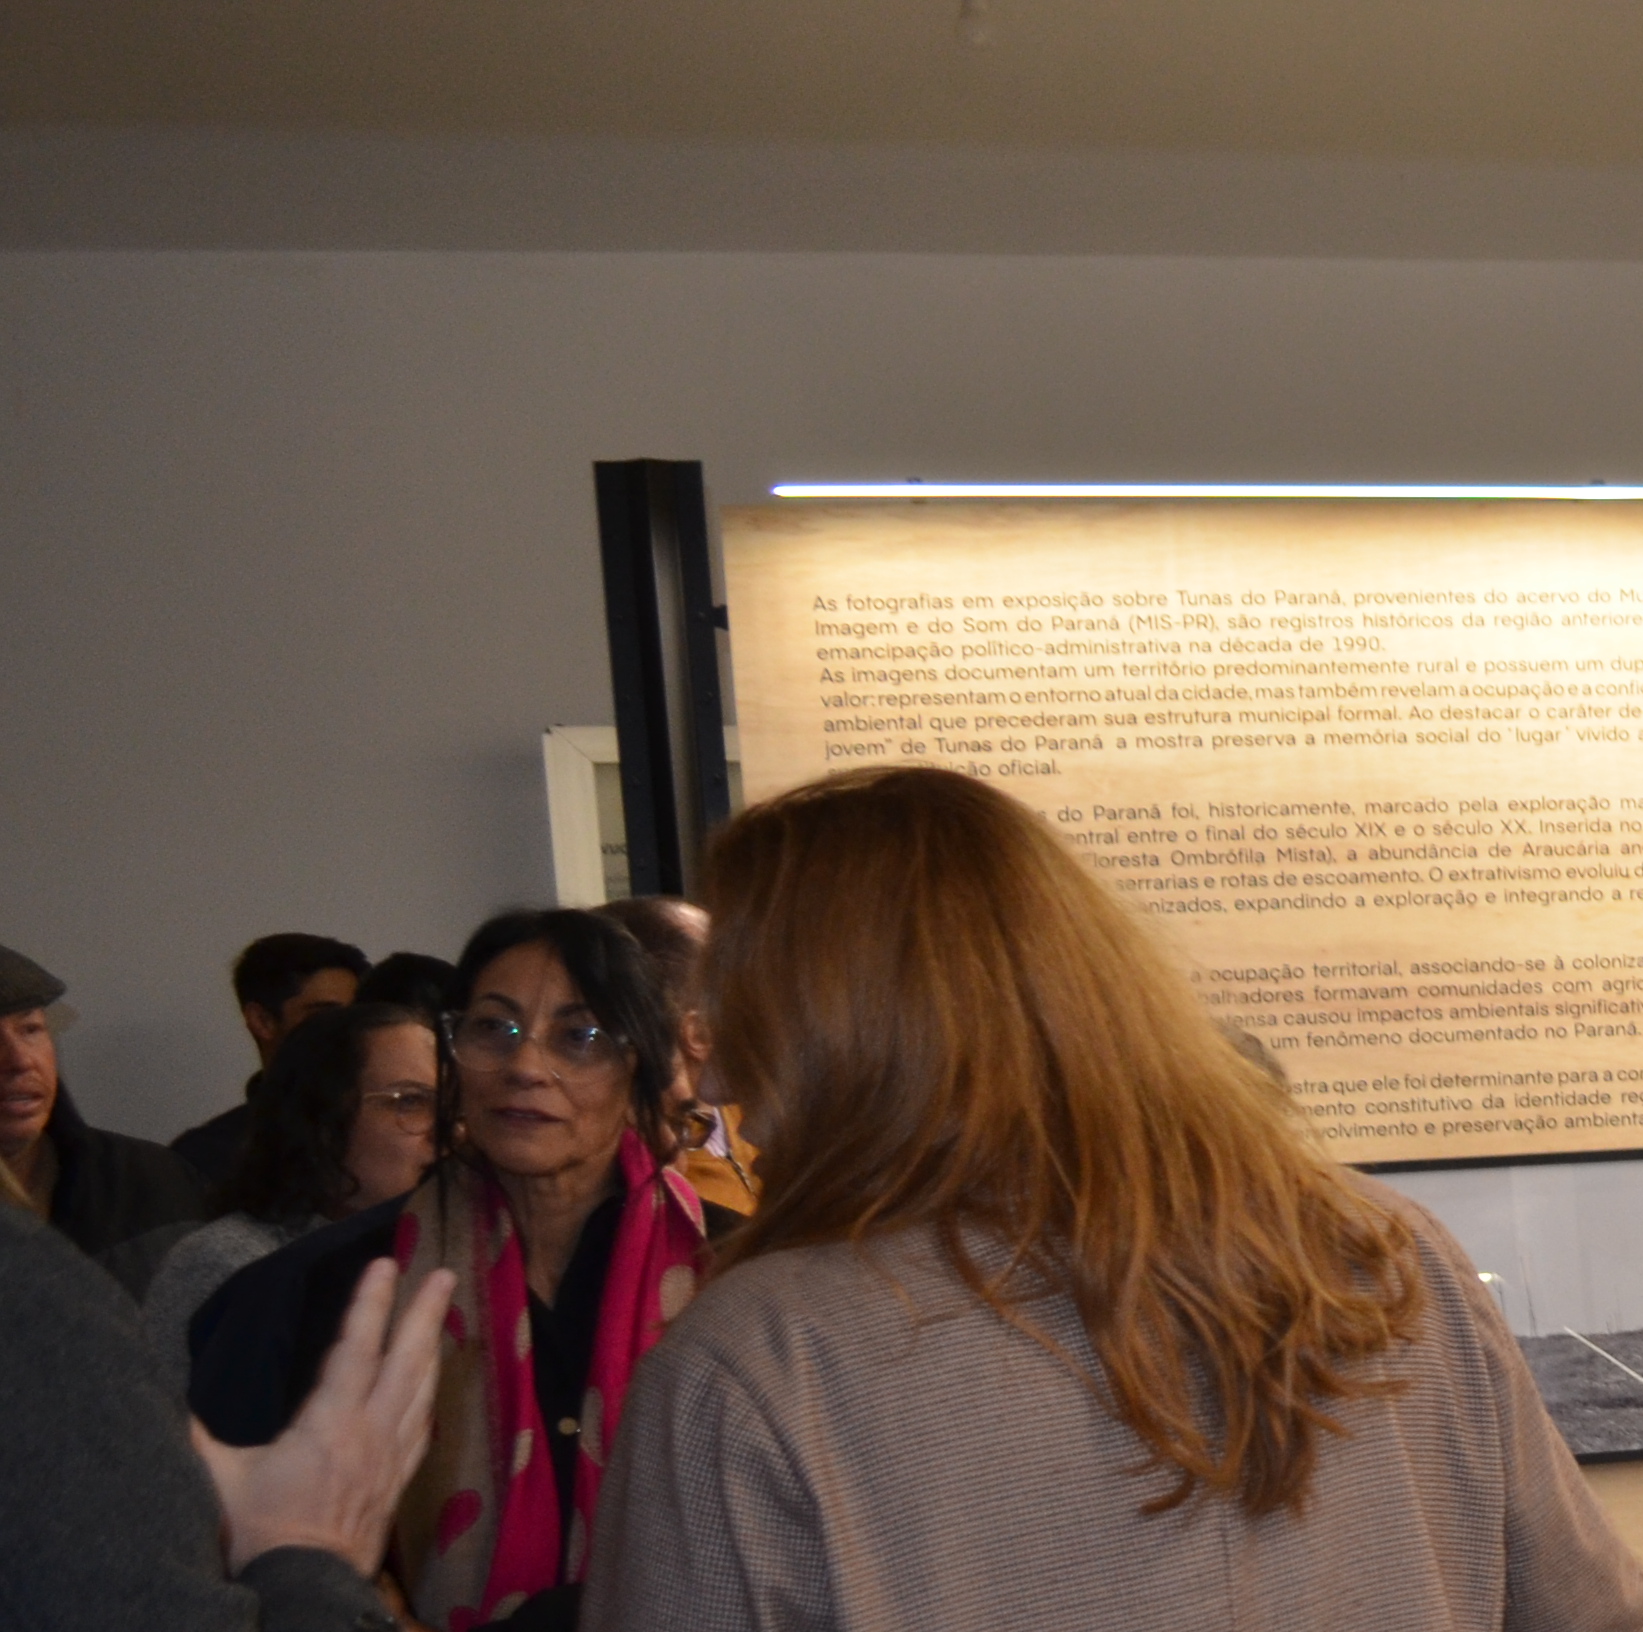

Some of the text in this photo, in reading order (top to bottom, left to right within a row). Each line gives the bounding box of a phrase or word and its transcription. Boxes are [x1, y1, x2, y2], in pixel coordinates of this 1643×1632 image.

[813, 595, 838, 612] As
[846, 593, 954, 615] fotografias
[962, 596, 994, 609] em
[1002, 592, 1104, 612] exposição
[1112, 591, 1168, 607] sobre
[1176, 589, 1233, 606] Tunas
[1241, 590, 1266, 605] do
[1274, 590, 1346, 606] Paraná,
[1354, 591, 1476, 608] provenientes
[1484, 589, 1508, 604] do
[1516, 592, 1580, 604] acervo
[1587, 589, 1611, 602] do
[815, 620, 898, 639] Imagem
[906, 622, 919, 635] e
[927, 617, 954, 634] do
[963, 617, 1008, 633] Som
[1016, 616, 1043, 632] do
[1051, 616, 1120, 631] Paraná
[1129, 614, 1220, 634] (MIS-PR),
[1227, 614, 1262, 629] são
[1270, 615, 1354, 633] registros
[1362, 613, 1453, 628] históricos
[1462, 613, 1485, 628] da
[1494, 613, 1552, 631] região
[816, 636, 1386, 662] emancipação político-administrativa na década de 1990.
[820, 667, 845, 684] As
[852, 667, 938, 686] imagens
[944, 664, 1077, 681] documentam
[1084, 665, 1115, 678] um
[1122, 661, 1206, 677] território
[1213, 660, 1410, 679] predominantemente
[1417, 657, 1458, 673] rural
[1466, 661, 1477, 673] e
[1484, 660, 1569, 676] possuem
[1575, 660, 1604, 672] um
[1271, 1021, 1642, 1049] um fenômeno documentado no Paraná.
